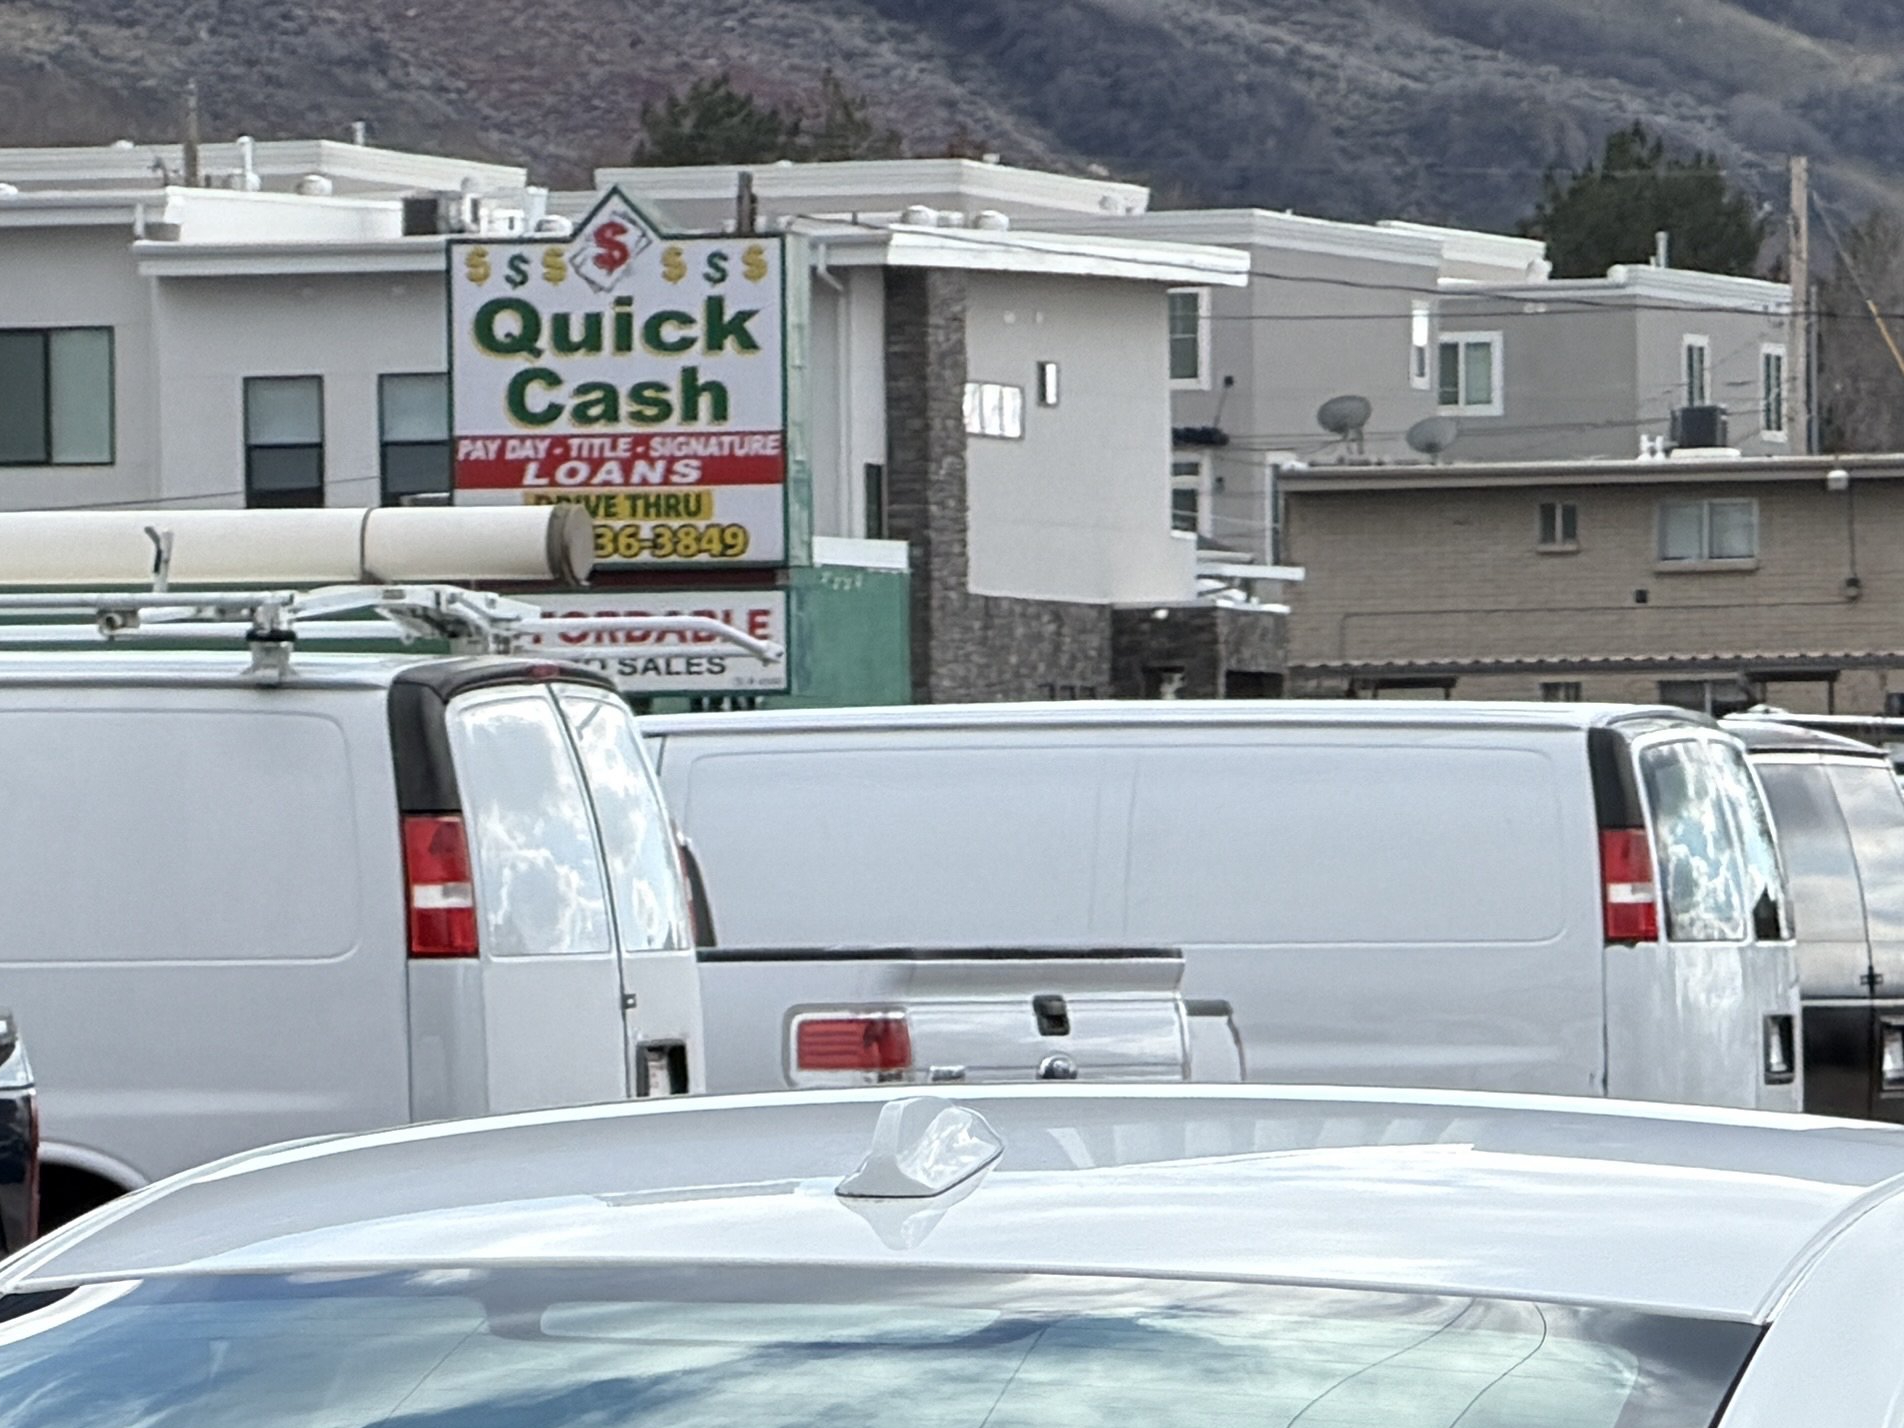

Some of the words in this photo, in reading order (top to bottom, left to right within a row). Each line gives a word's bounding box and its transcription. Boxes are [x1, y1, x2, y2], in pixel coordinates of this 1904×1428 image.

[472, 295, 761, 360] Quick
[506, 365, 729, 427] Cash
[457, 438, 501, 461] PAY
[504, 437, 552, 460] DAY
[568, 436, 633, 459] TITLE
[649, 433, 782, 458] SIGNATURE
[522, 459, 703, 487] LOANS
[630, 493, 703, 519] THRU
[617, 657, 727, 676] SALES
